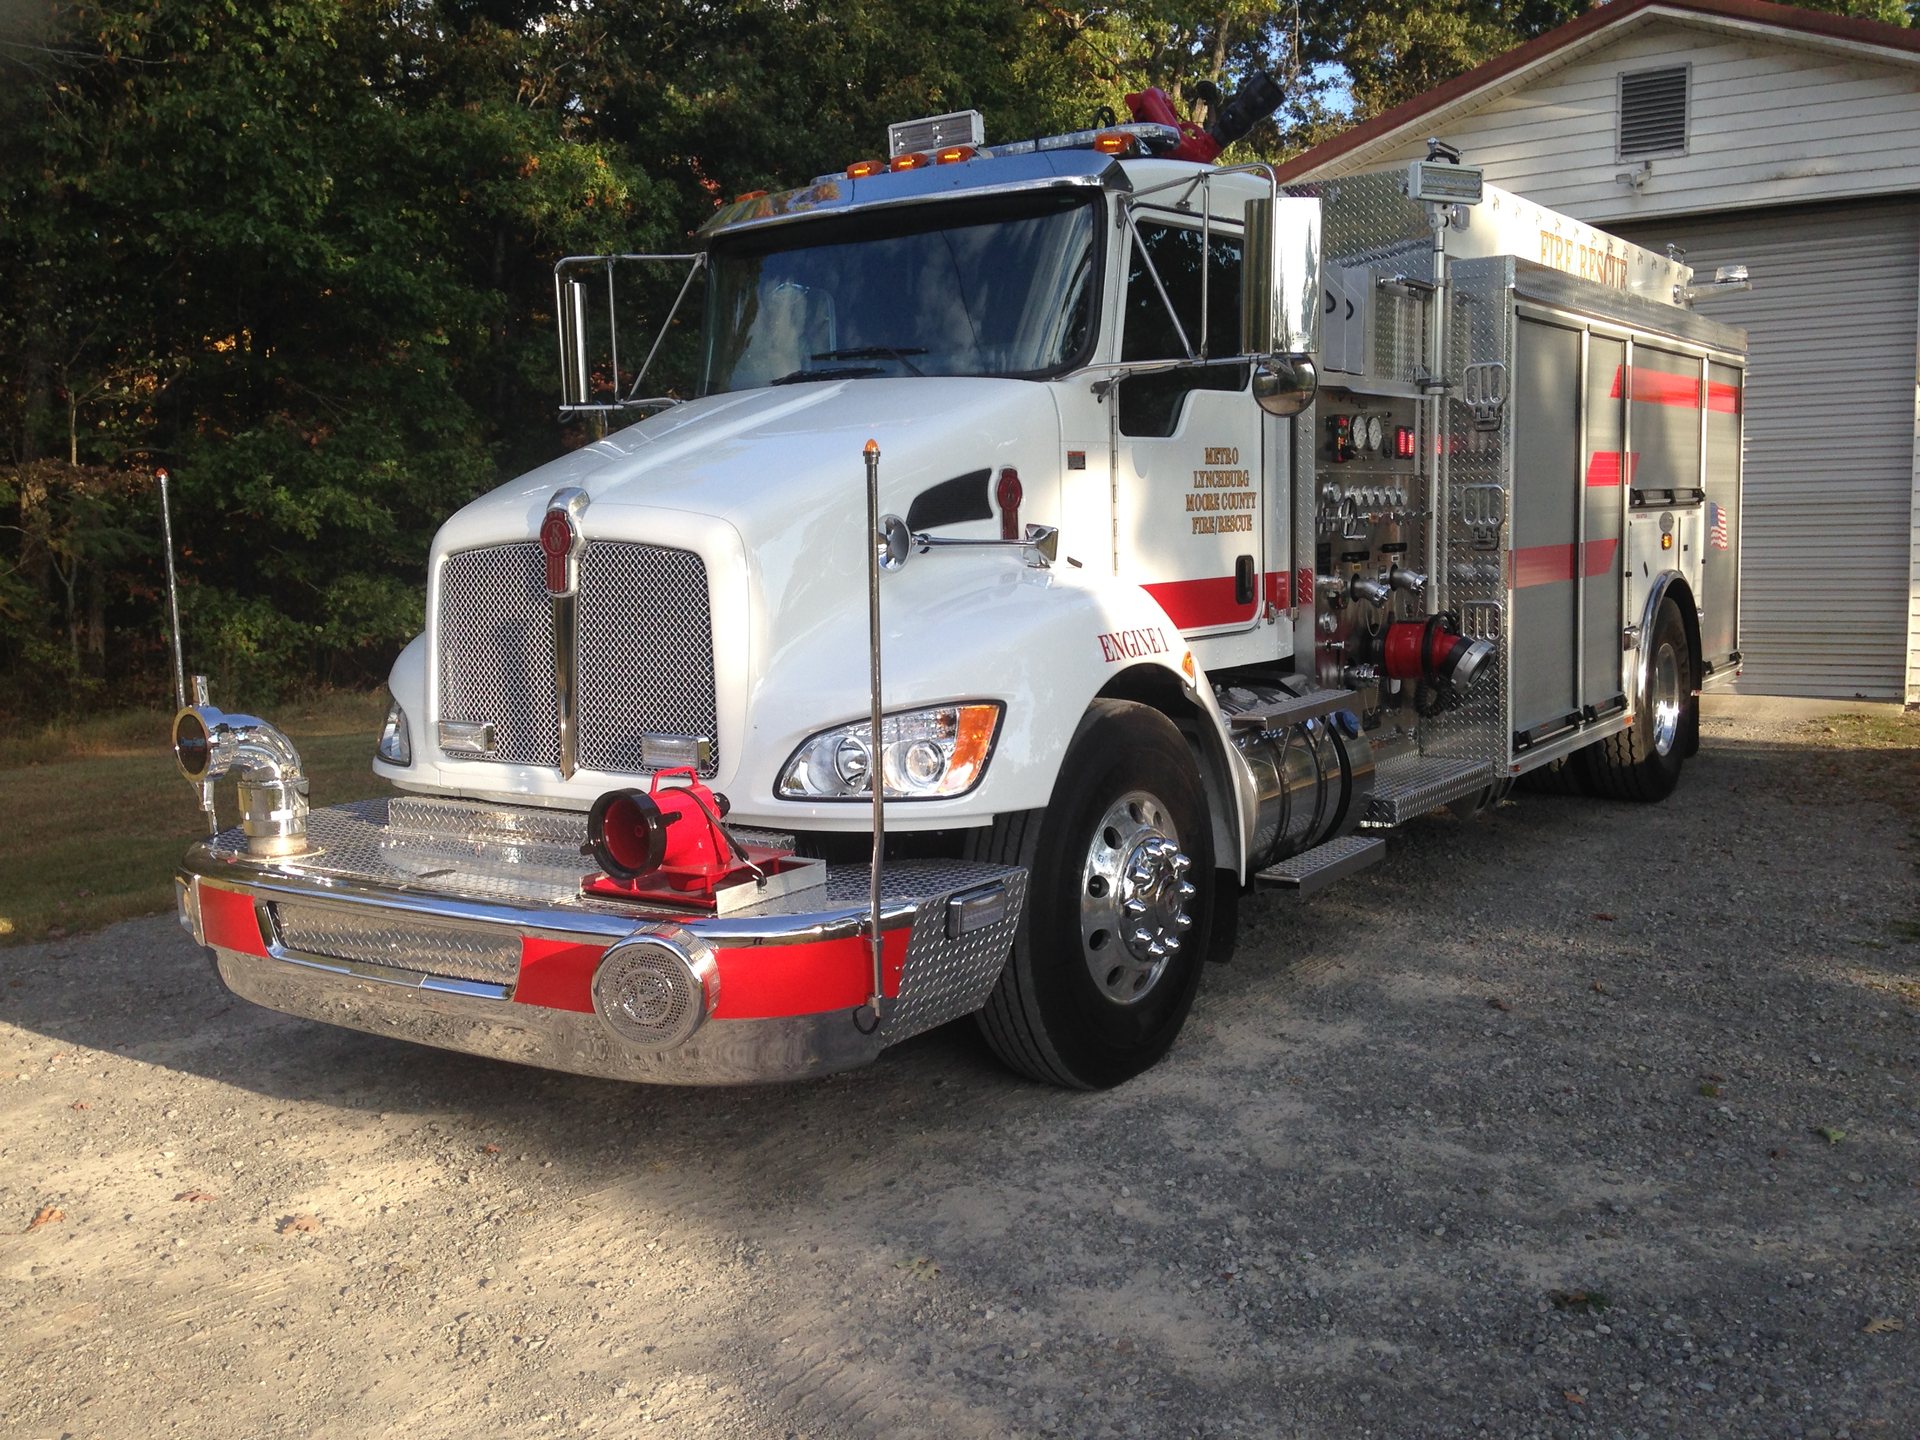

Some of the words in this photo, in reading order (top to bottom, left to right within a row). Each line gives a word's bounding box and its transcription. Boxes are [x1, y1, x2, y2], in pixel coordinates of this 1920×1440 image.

[1205, 447, 1238, 465] METRO
[1193, 470, 1249, 488] LYNCHBURG
[1185, 493, 1219, 511] MOORE
[1221, 492, 1257, 510] COUNTY
[1097, 627, 1161, 662] ENGINE
